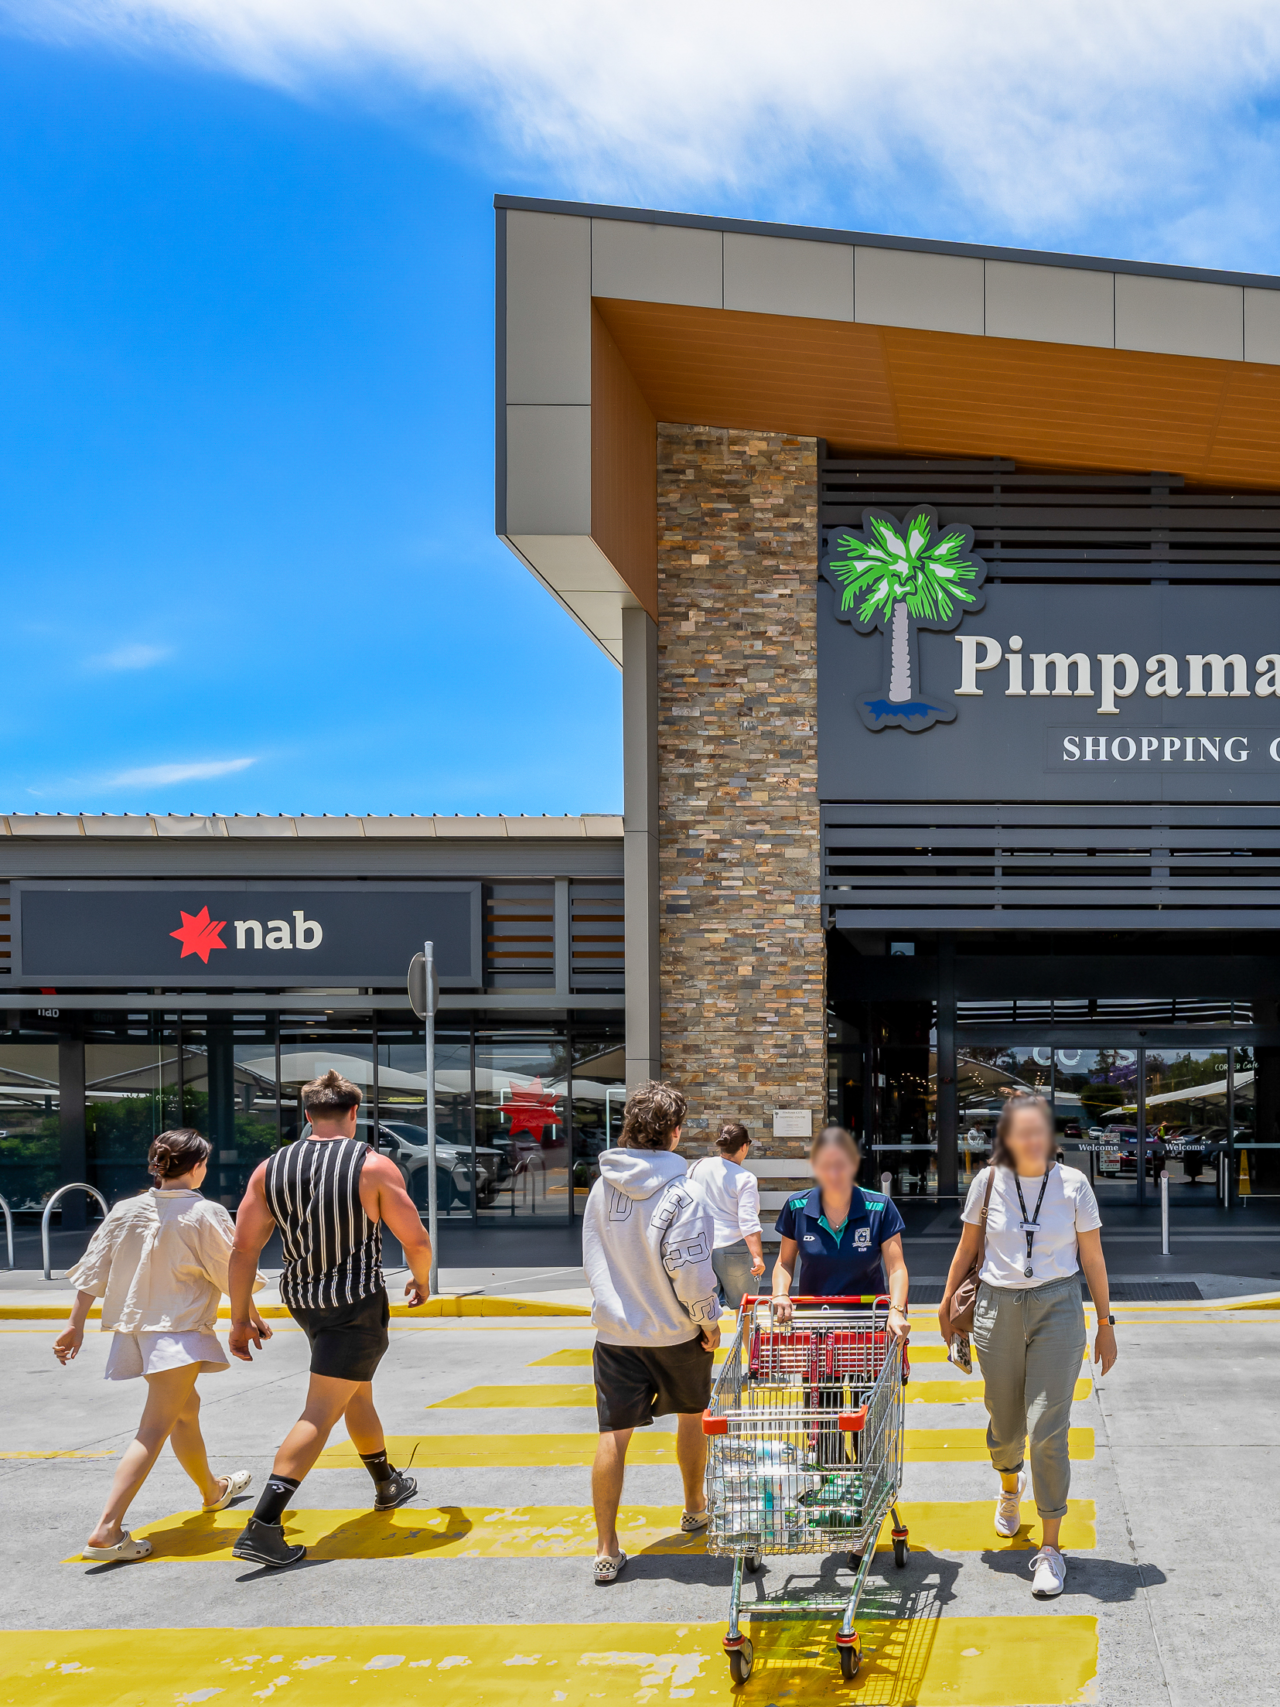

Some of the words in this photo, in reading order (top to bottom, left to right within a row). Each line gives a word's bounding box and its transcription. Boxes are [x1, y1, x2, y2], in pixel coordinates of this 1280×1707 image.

[1063, 736, 1249, 762] SHOPPING
[234, 910, 323, 950] nab
[1214, 1062, 1241, 1072] CORER
[1079, 1143, 1119, 1151] Welcome
[1165, 1143, 1206, 1151] Welcome
